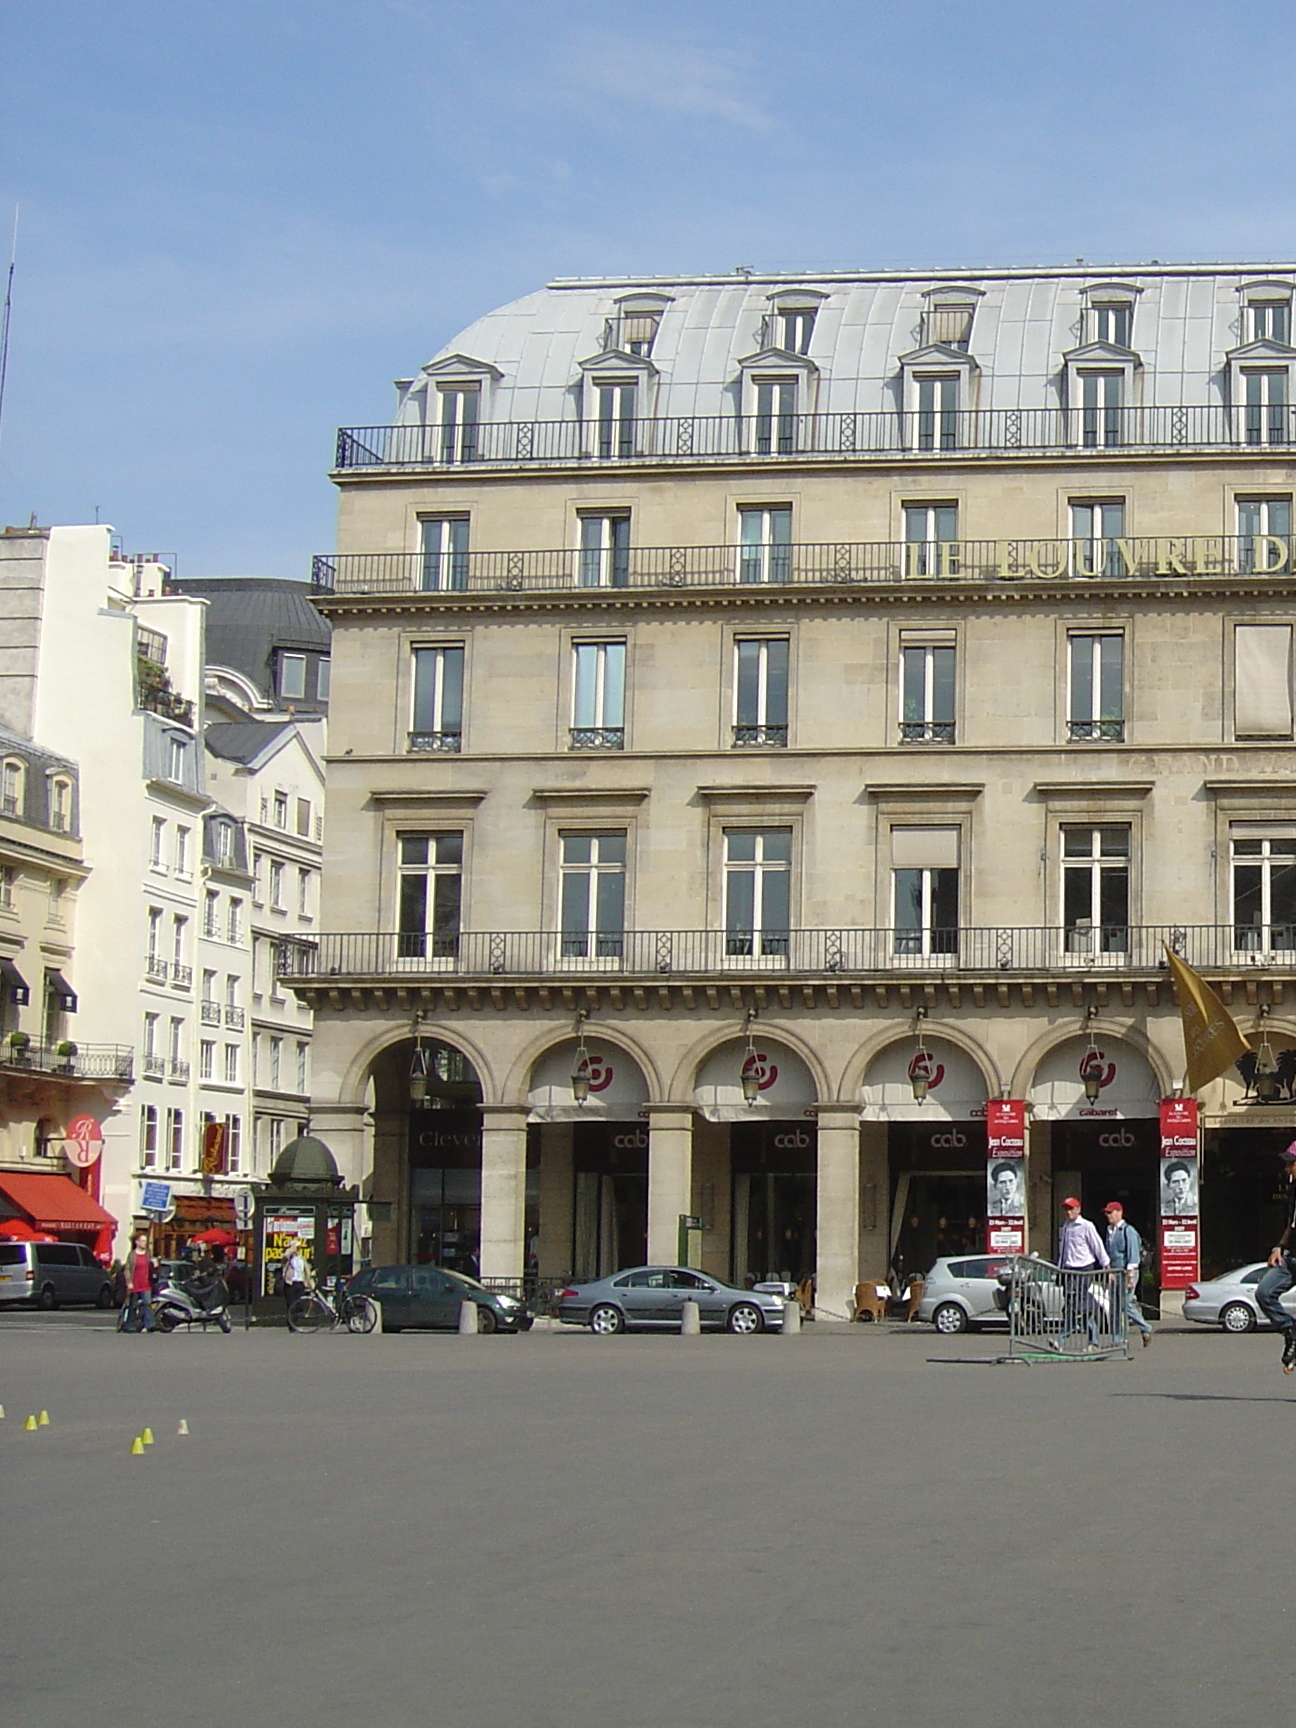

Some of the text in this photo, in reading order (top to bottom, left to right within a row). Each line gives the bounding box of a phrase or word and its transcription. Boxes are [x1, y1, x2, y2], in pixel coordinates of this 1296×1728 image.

[906, 541, 966, 579] LE
[999, 536, 1221, 579] LOUVRE
[1128, 754, 1240, 775] GRAND
[1078, 1107, 1118, 1116] cabaret
[614, 1129, 648, 1148] cab
[774, 1129, 810, 1148] cab
[930, 1127, 967, 1148] cab
[1099, 1127, 1135, 1148] cab
